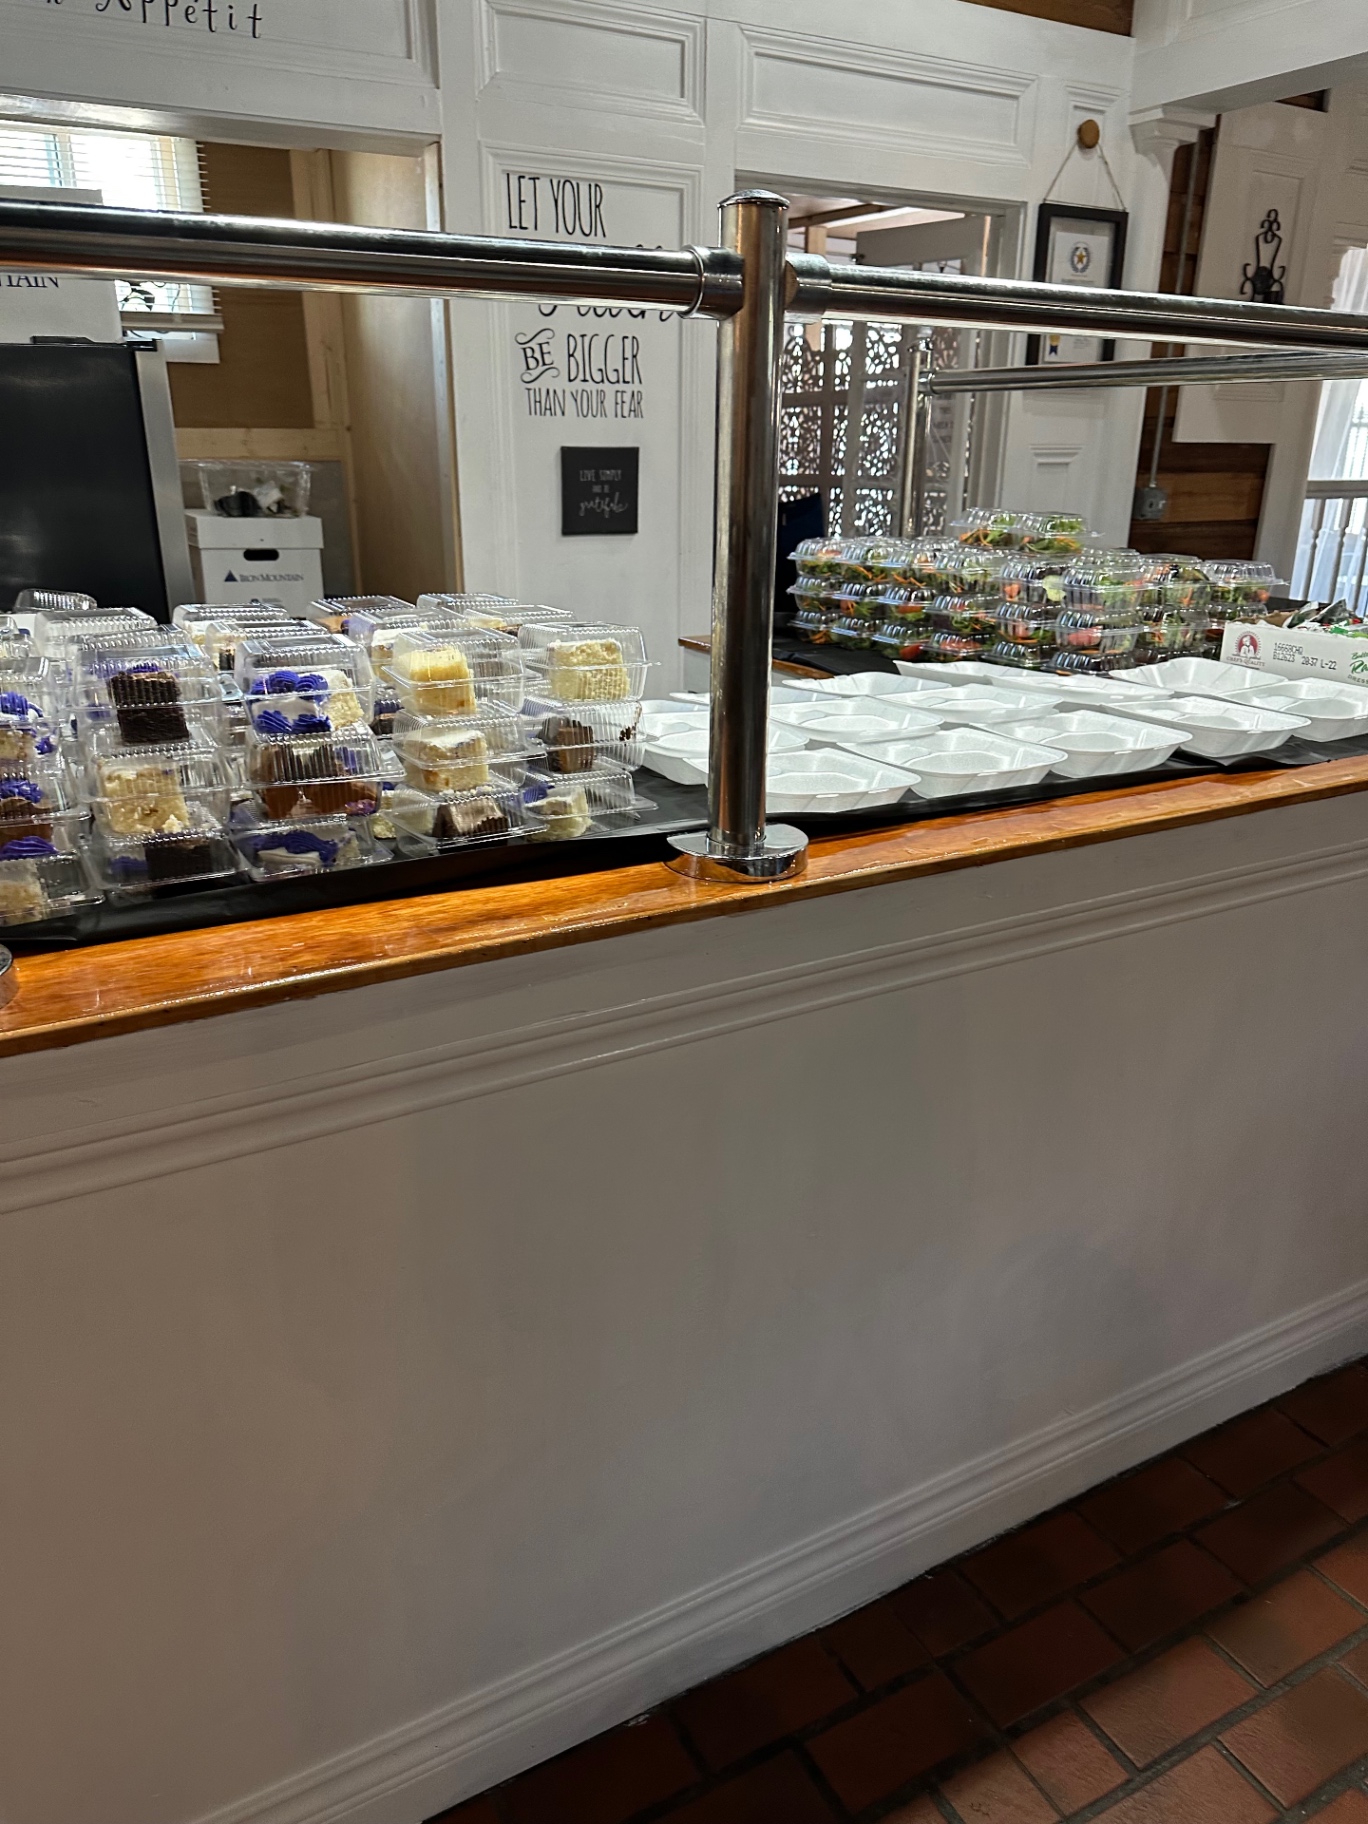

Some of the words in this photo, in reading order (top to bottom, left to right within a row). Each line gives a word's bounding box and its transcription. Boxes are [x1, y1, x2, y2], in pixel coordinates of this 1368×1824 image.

[506, 173, 540, 231] LET
[550, 178, 606, 238] YOUR
[520, 342, 554, 371] BE
[567, 333, 643, 384] BIGGER
[525, 387, 566, 417] THAN
[570, 388, 607, 418] YOUR
[614, 390, 644, 418] FEAR
